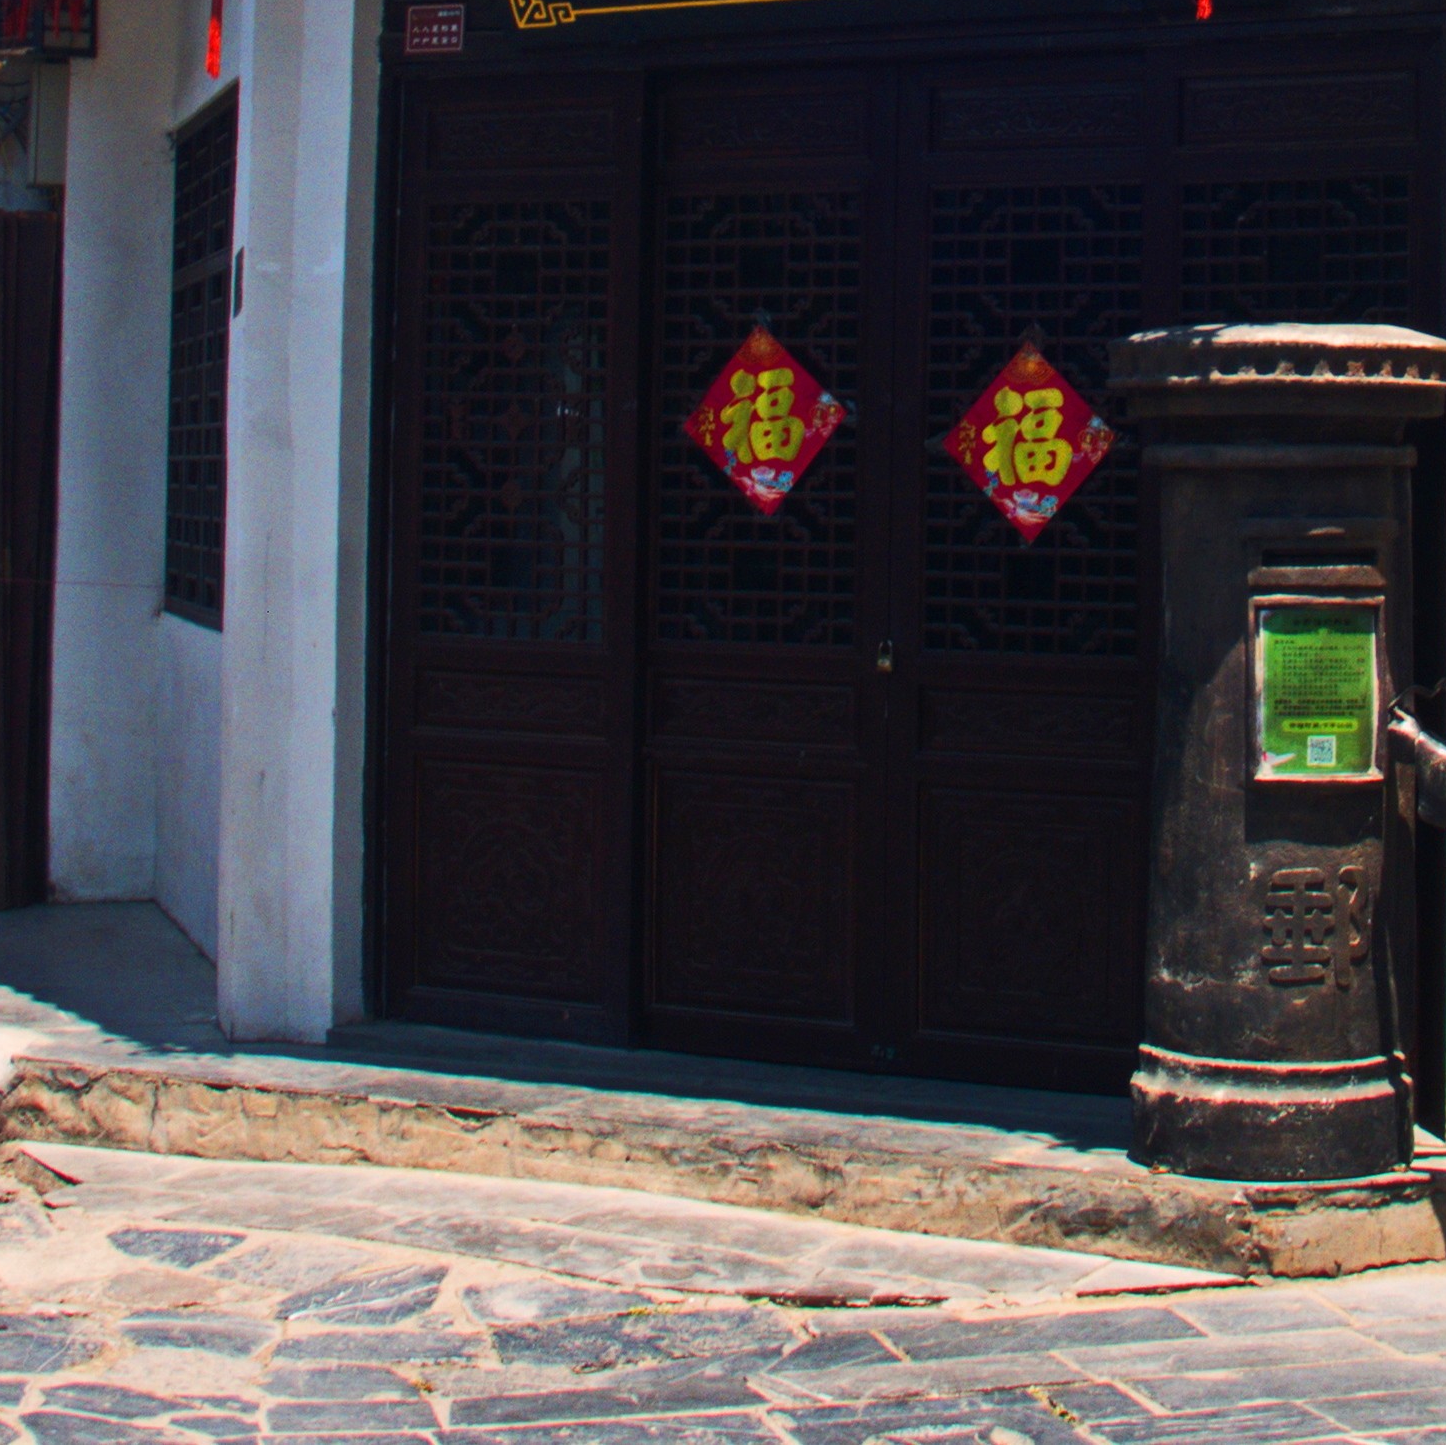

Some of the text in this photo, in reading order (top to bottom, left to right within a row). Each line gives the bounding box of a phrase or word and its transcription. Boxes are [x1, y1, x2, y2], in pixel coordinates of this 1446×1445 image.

[720, 367, 805, 464] 福
[982, 386, 1073, 486] 福
[1260, 866, 1371, 990] 郵
